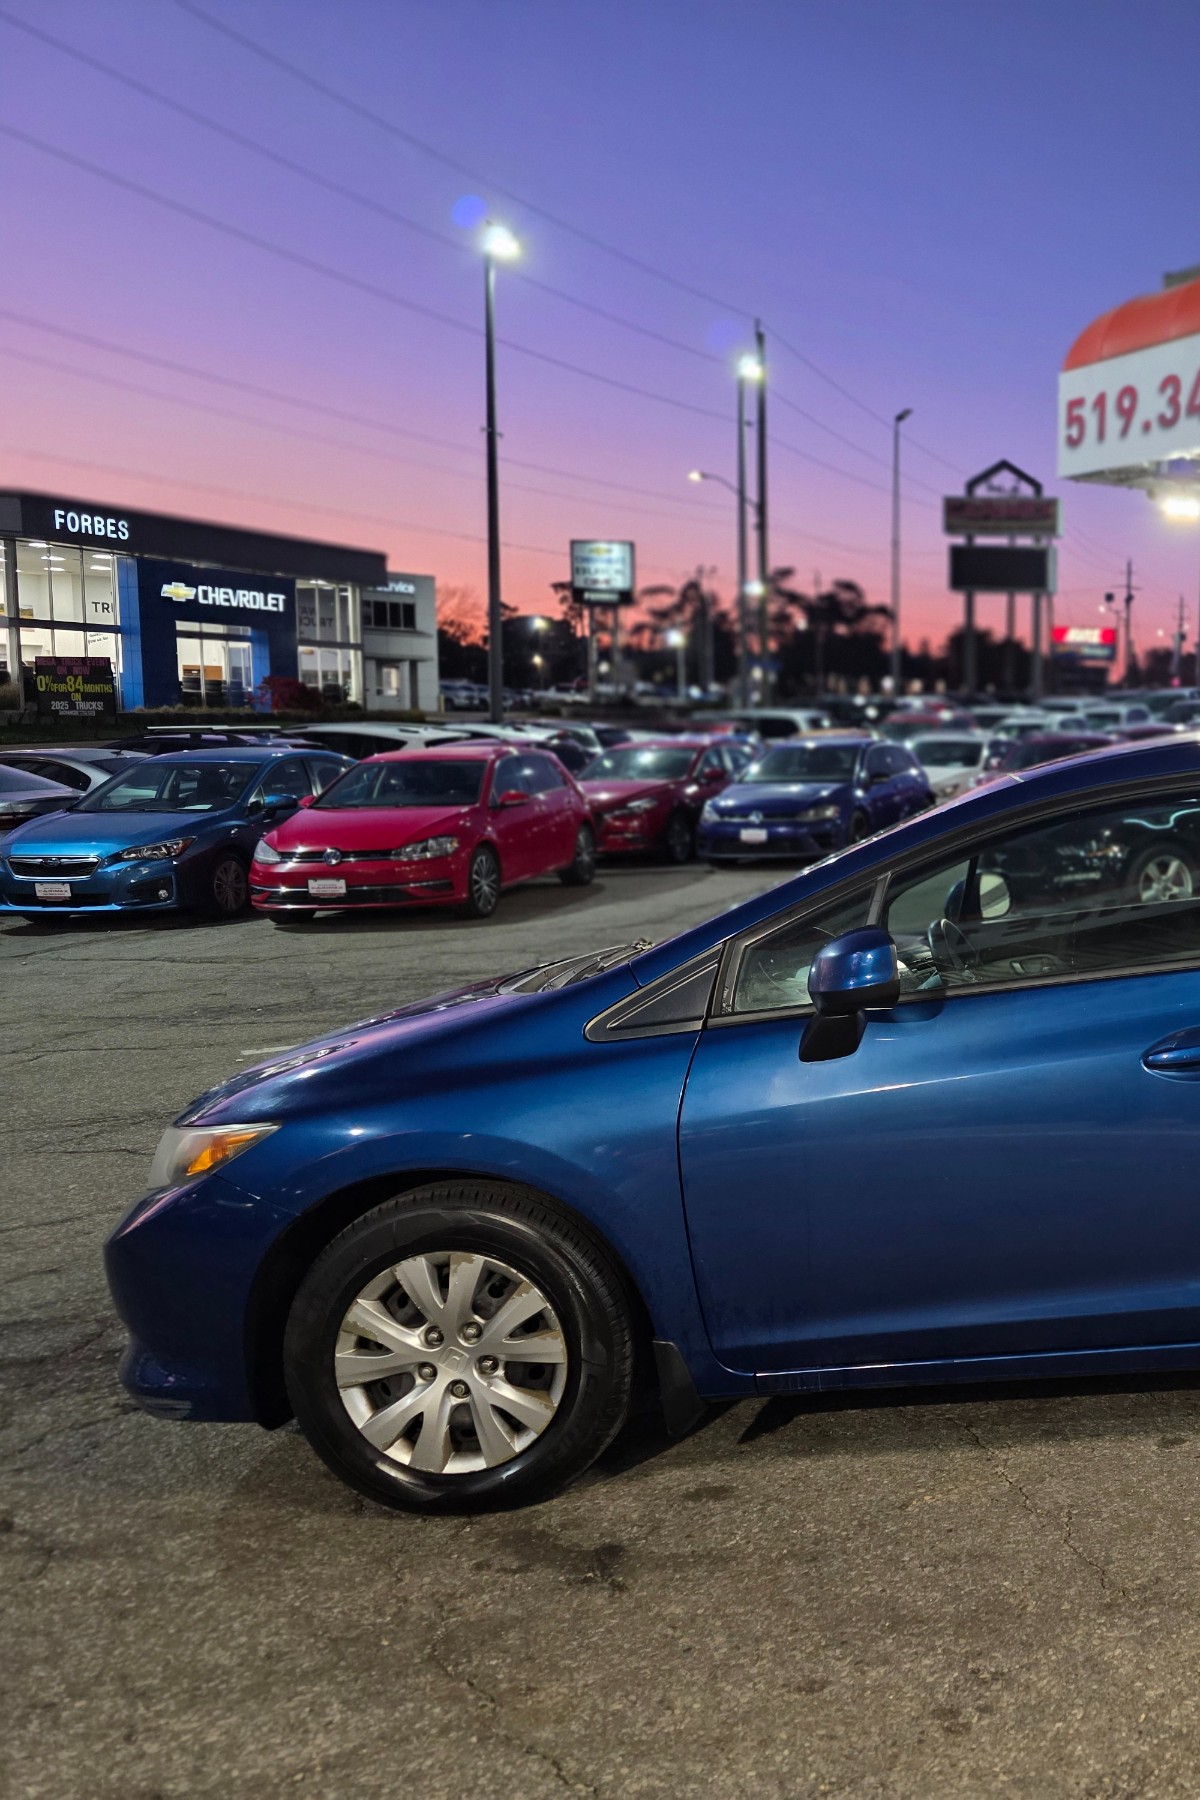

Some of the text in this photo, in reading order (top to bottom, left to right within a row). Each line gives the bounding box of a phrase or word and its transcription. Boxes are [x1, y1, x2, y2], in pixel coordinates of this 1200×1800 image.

[54, 509, 130, 541] FORBES
[197, 585, 286, 612] CHEVROLET
[91, 601, 114, 613] TR
[62, 658, 82, 666] TRUCK
[87, 658, 108, 667] EVENT
[58, 667, 90, 675] ON NOW
[85, 684, 113, 693] MONTHS
[71, 693, 82, 702] ON
[51, 701, 104, 711] 2025 TRUCKS!
